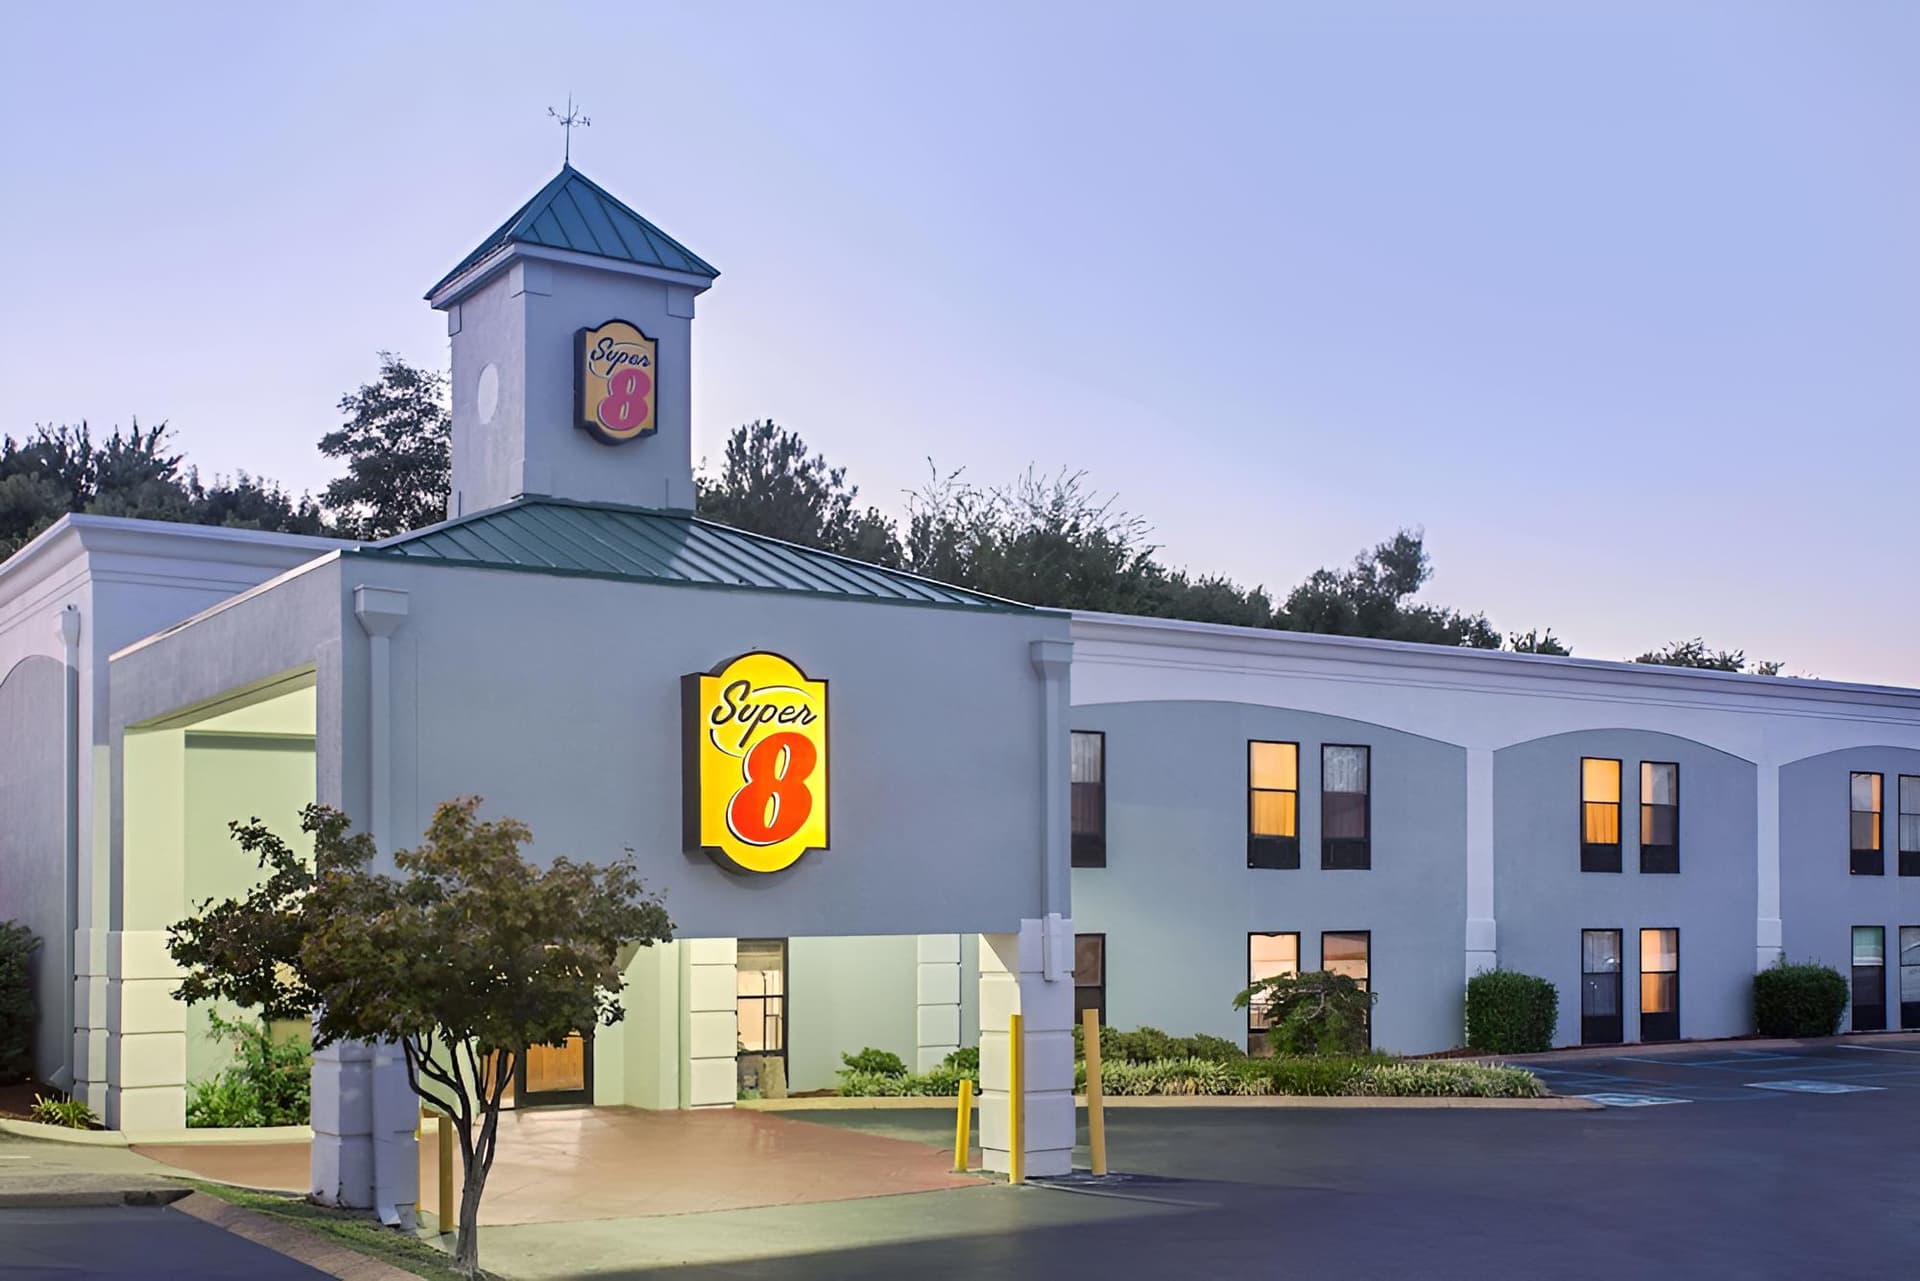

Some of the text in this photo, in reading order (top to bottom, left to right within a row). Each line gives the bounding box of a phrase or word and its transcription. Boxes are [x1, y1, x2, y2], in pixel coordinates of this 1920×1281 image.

[590, 337, 651, 376] Super
[597, 368, 651, 431] 8
[711, 679, 817, 748] Super
[726, 731, 817, 846] 8
